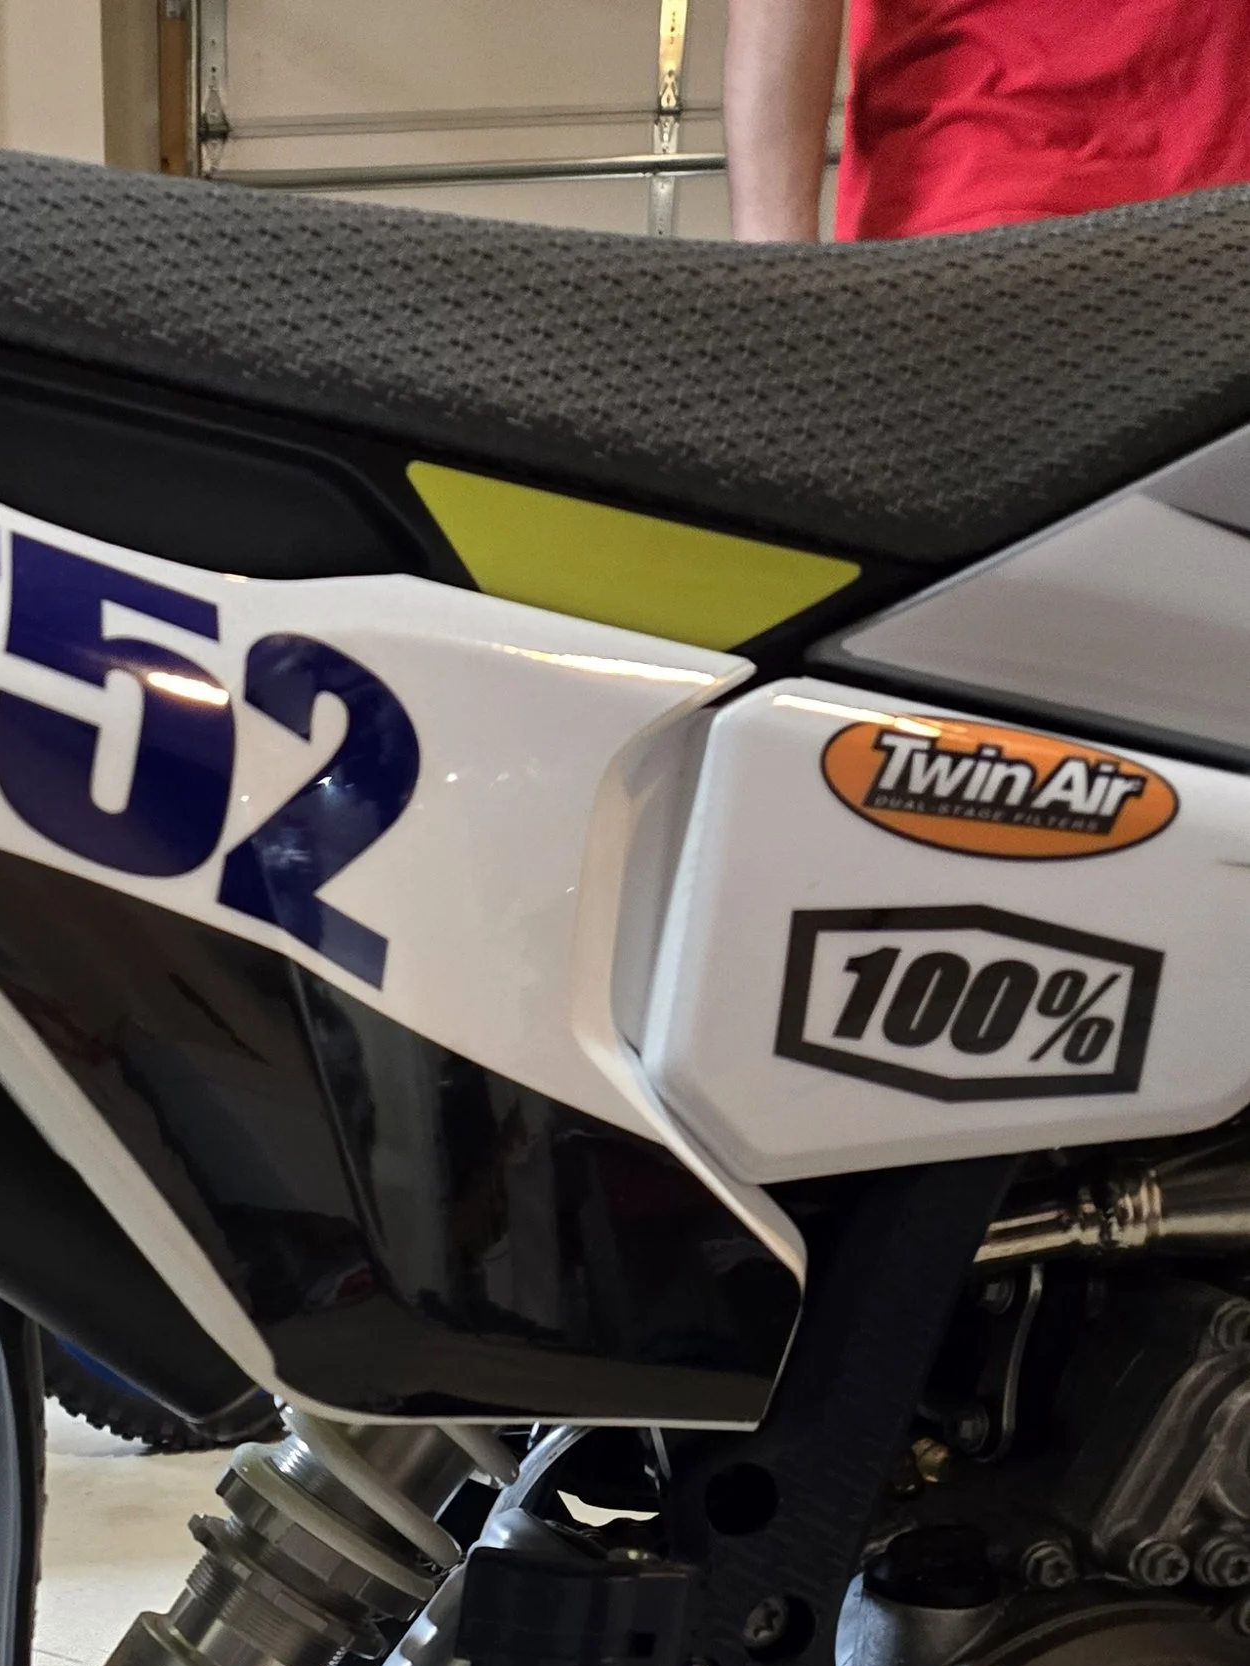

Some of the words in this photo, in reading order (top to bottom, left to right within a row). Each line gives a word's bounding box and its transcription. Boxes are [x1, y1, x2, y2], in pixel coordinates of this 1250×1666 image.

[876, 733, 1034, 807] Twin
[1029, 758, 1138, 817] Air
[832, 946, 1121, 1066] 100%
